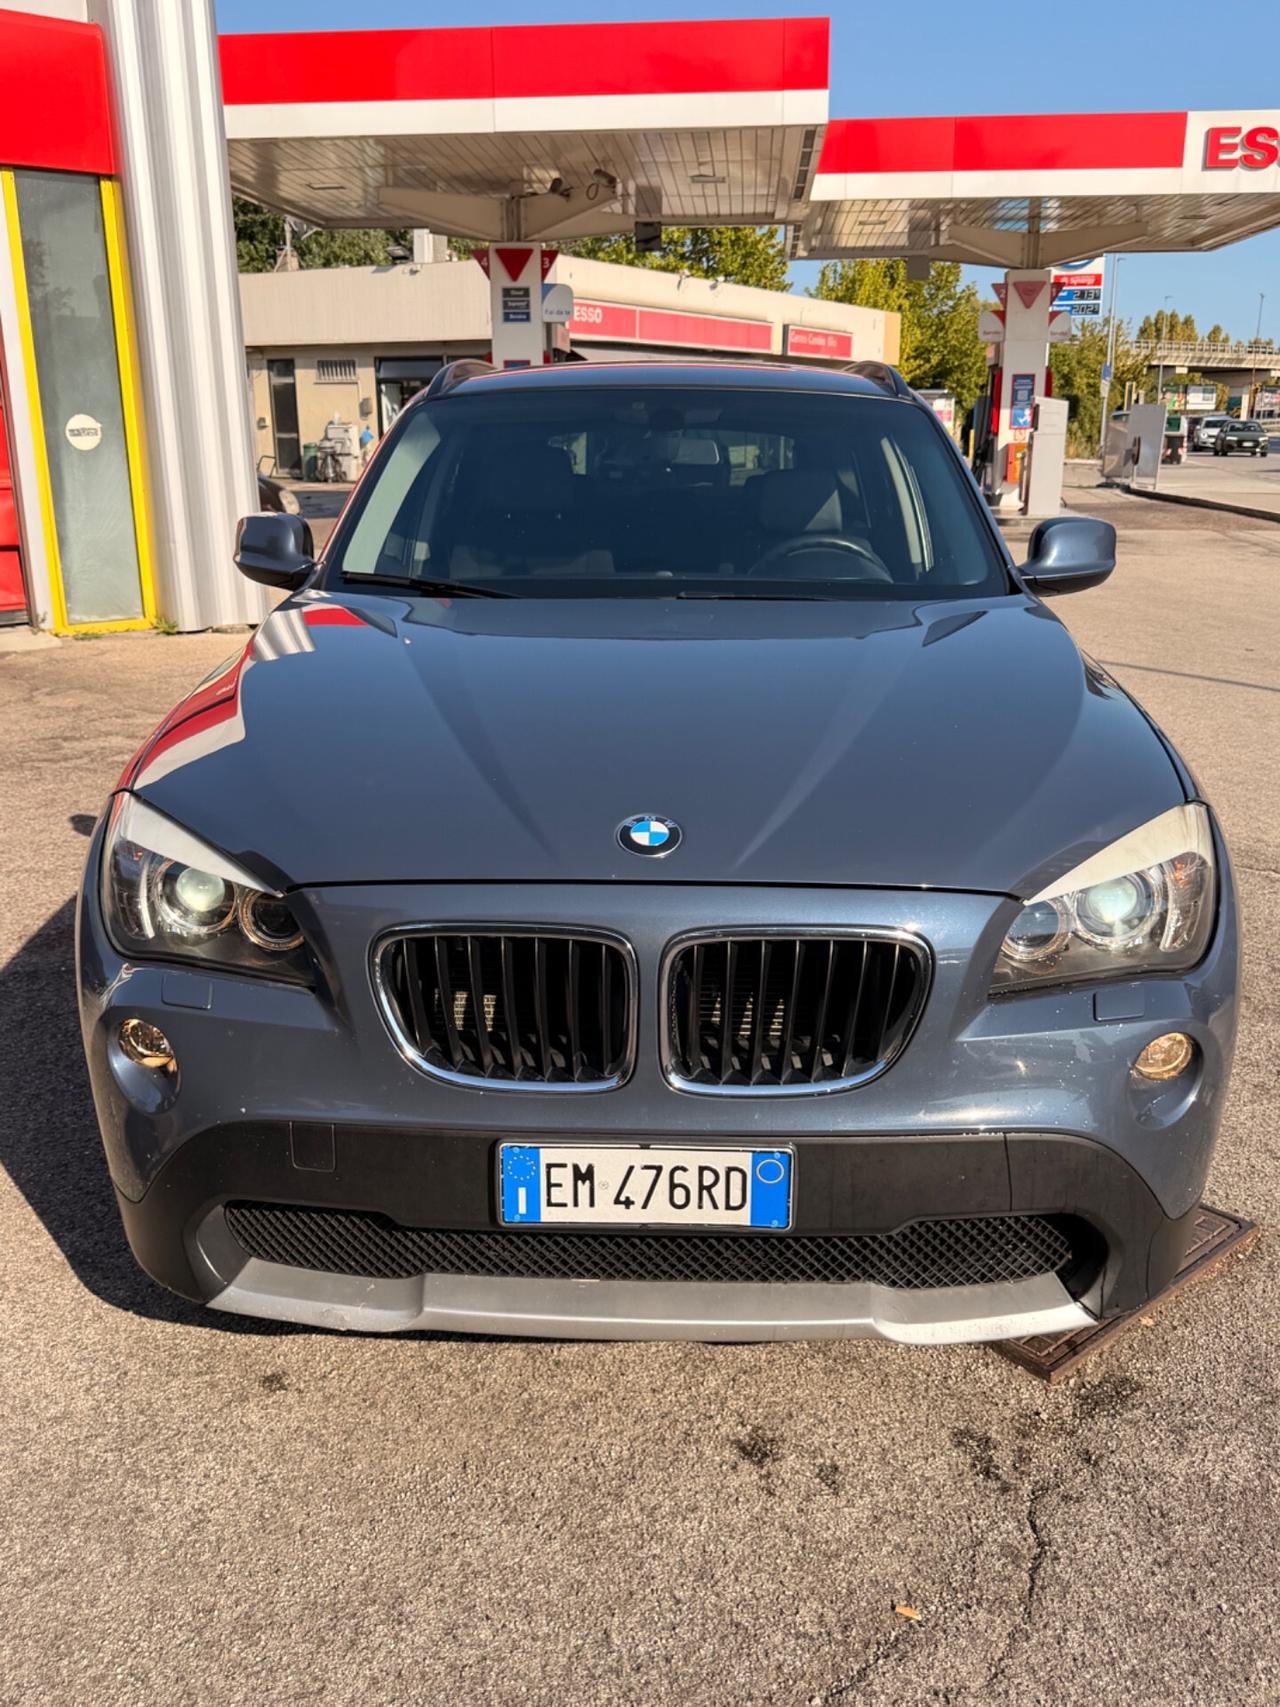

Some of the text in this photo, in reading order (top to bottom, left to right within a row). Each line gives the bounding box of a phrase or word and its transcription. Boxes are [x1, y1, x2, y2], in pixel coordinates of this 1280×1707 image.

[1203, 126, 1280, 171] ES
[481, 258, 488, 267] 4
[543, 258, 550, 268] 3
[573, 305, 602, 324] ESSO
[545, 1162, 748, 1211] EM 476RD
[518, 1187, 527, 1214] I
